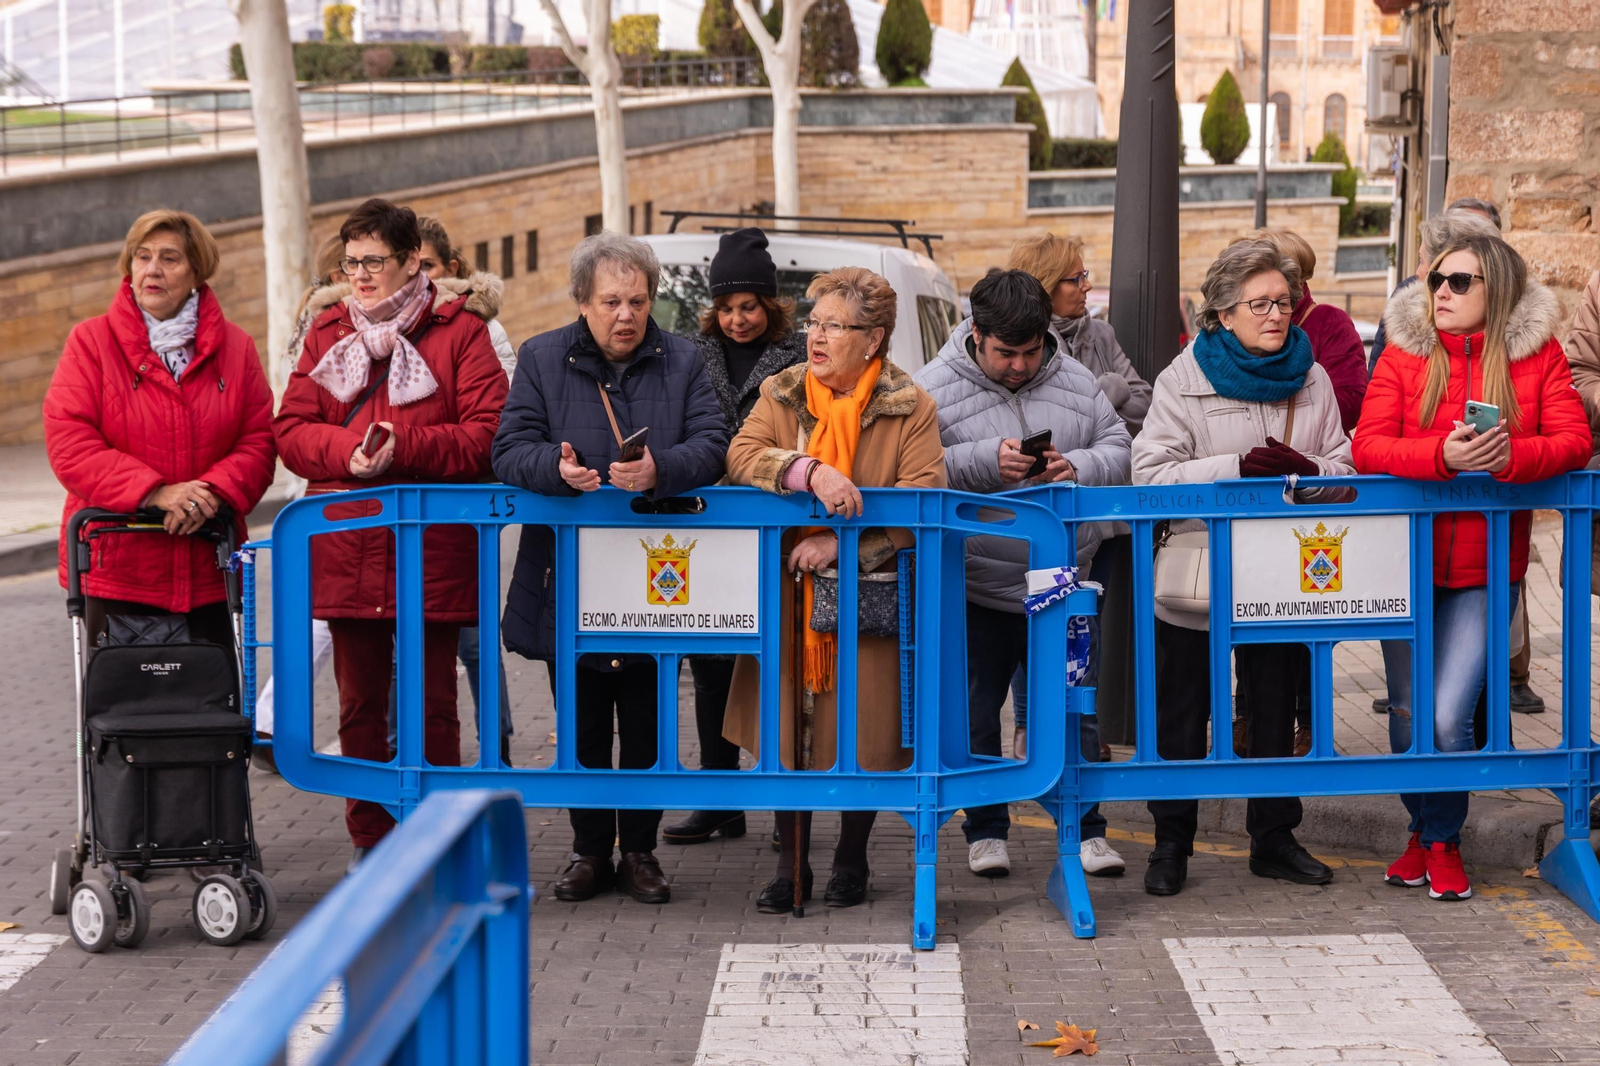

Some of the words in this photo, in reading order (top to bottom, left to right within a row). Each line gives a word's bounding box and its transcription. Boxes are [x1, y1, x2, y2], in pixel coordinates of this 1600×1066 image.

[1138, 492, 1204, 510] POLICIA
[1215, 491, 1269, 508] LOCAL
[1422, 484, 1520, 503] LINARES
[489, 494, 516, 518] 15
[1236, 602, 1273, 618] EXCMO.
[1275, 600, 1348, 616] AYUNTAMIENTO
[1351, 599, 1364, 614] DE
[1366, 598, 1407, 614] LINARES
[582, 612, 619, 627] EXCMO.
[621, 613, 695, 628] AYUNTAMIENTO
[698, 614, 711, 629] DE
[713, 614, 755, 629] LINARES
[140, 662, 182, 672] CARLETT
